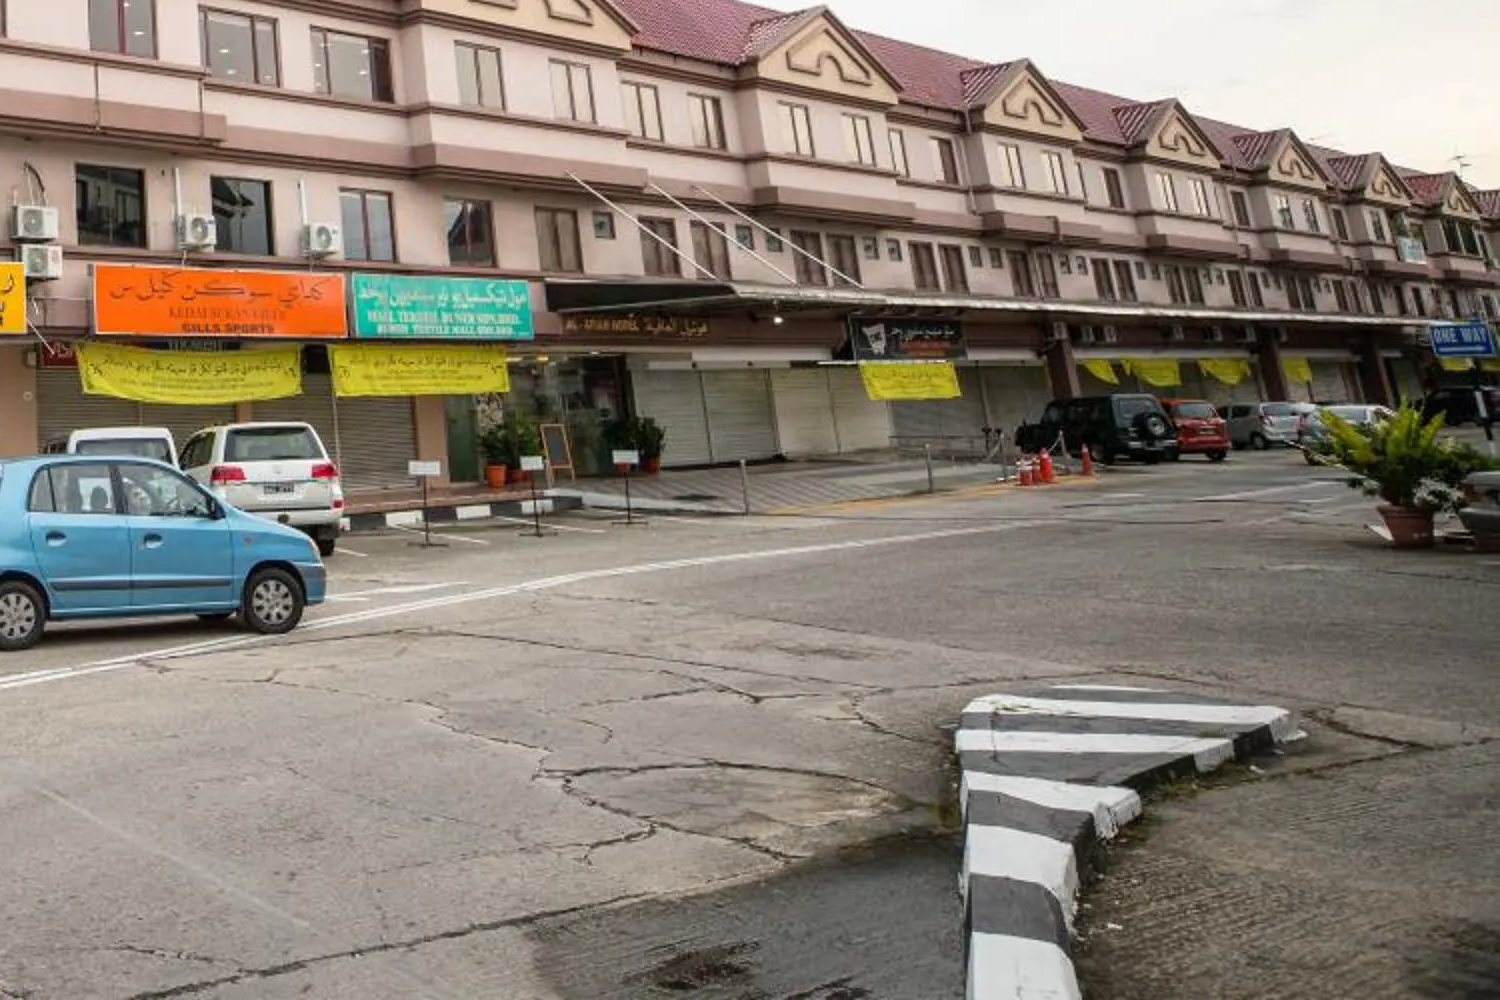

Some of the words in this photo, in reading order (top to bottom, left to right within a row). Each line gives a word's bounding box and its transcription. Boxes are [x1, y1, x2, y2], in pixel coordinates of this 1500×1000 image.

[225, 322, 275, 335] SPORTS
[1433, 327, 1458, 344] ONE
[1460, 327, 1487, 343] WAY
